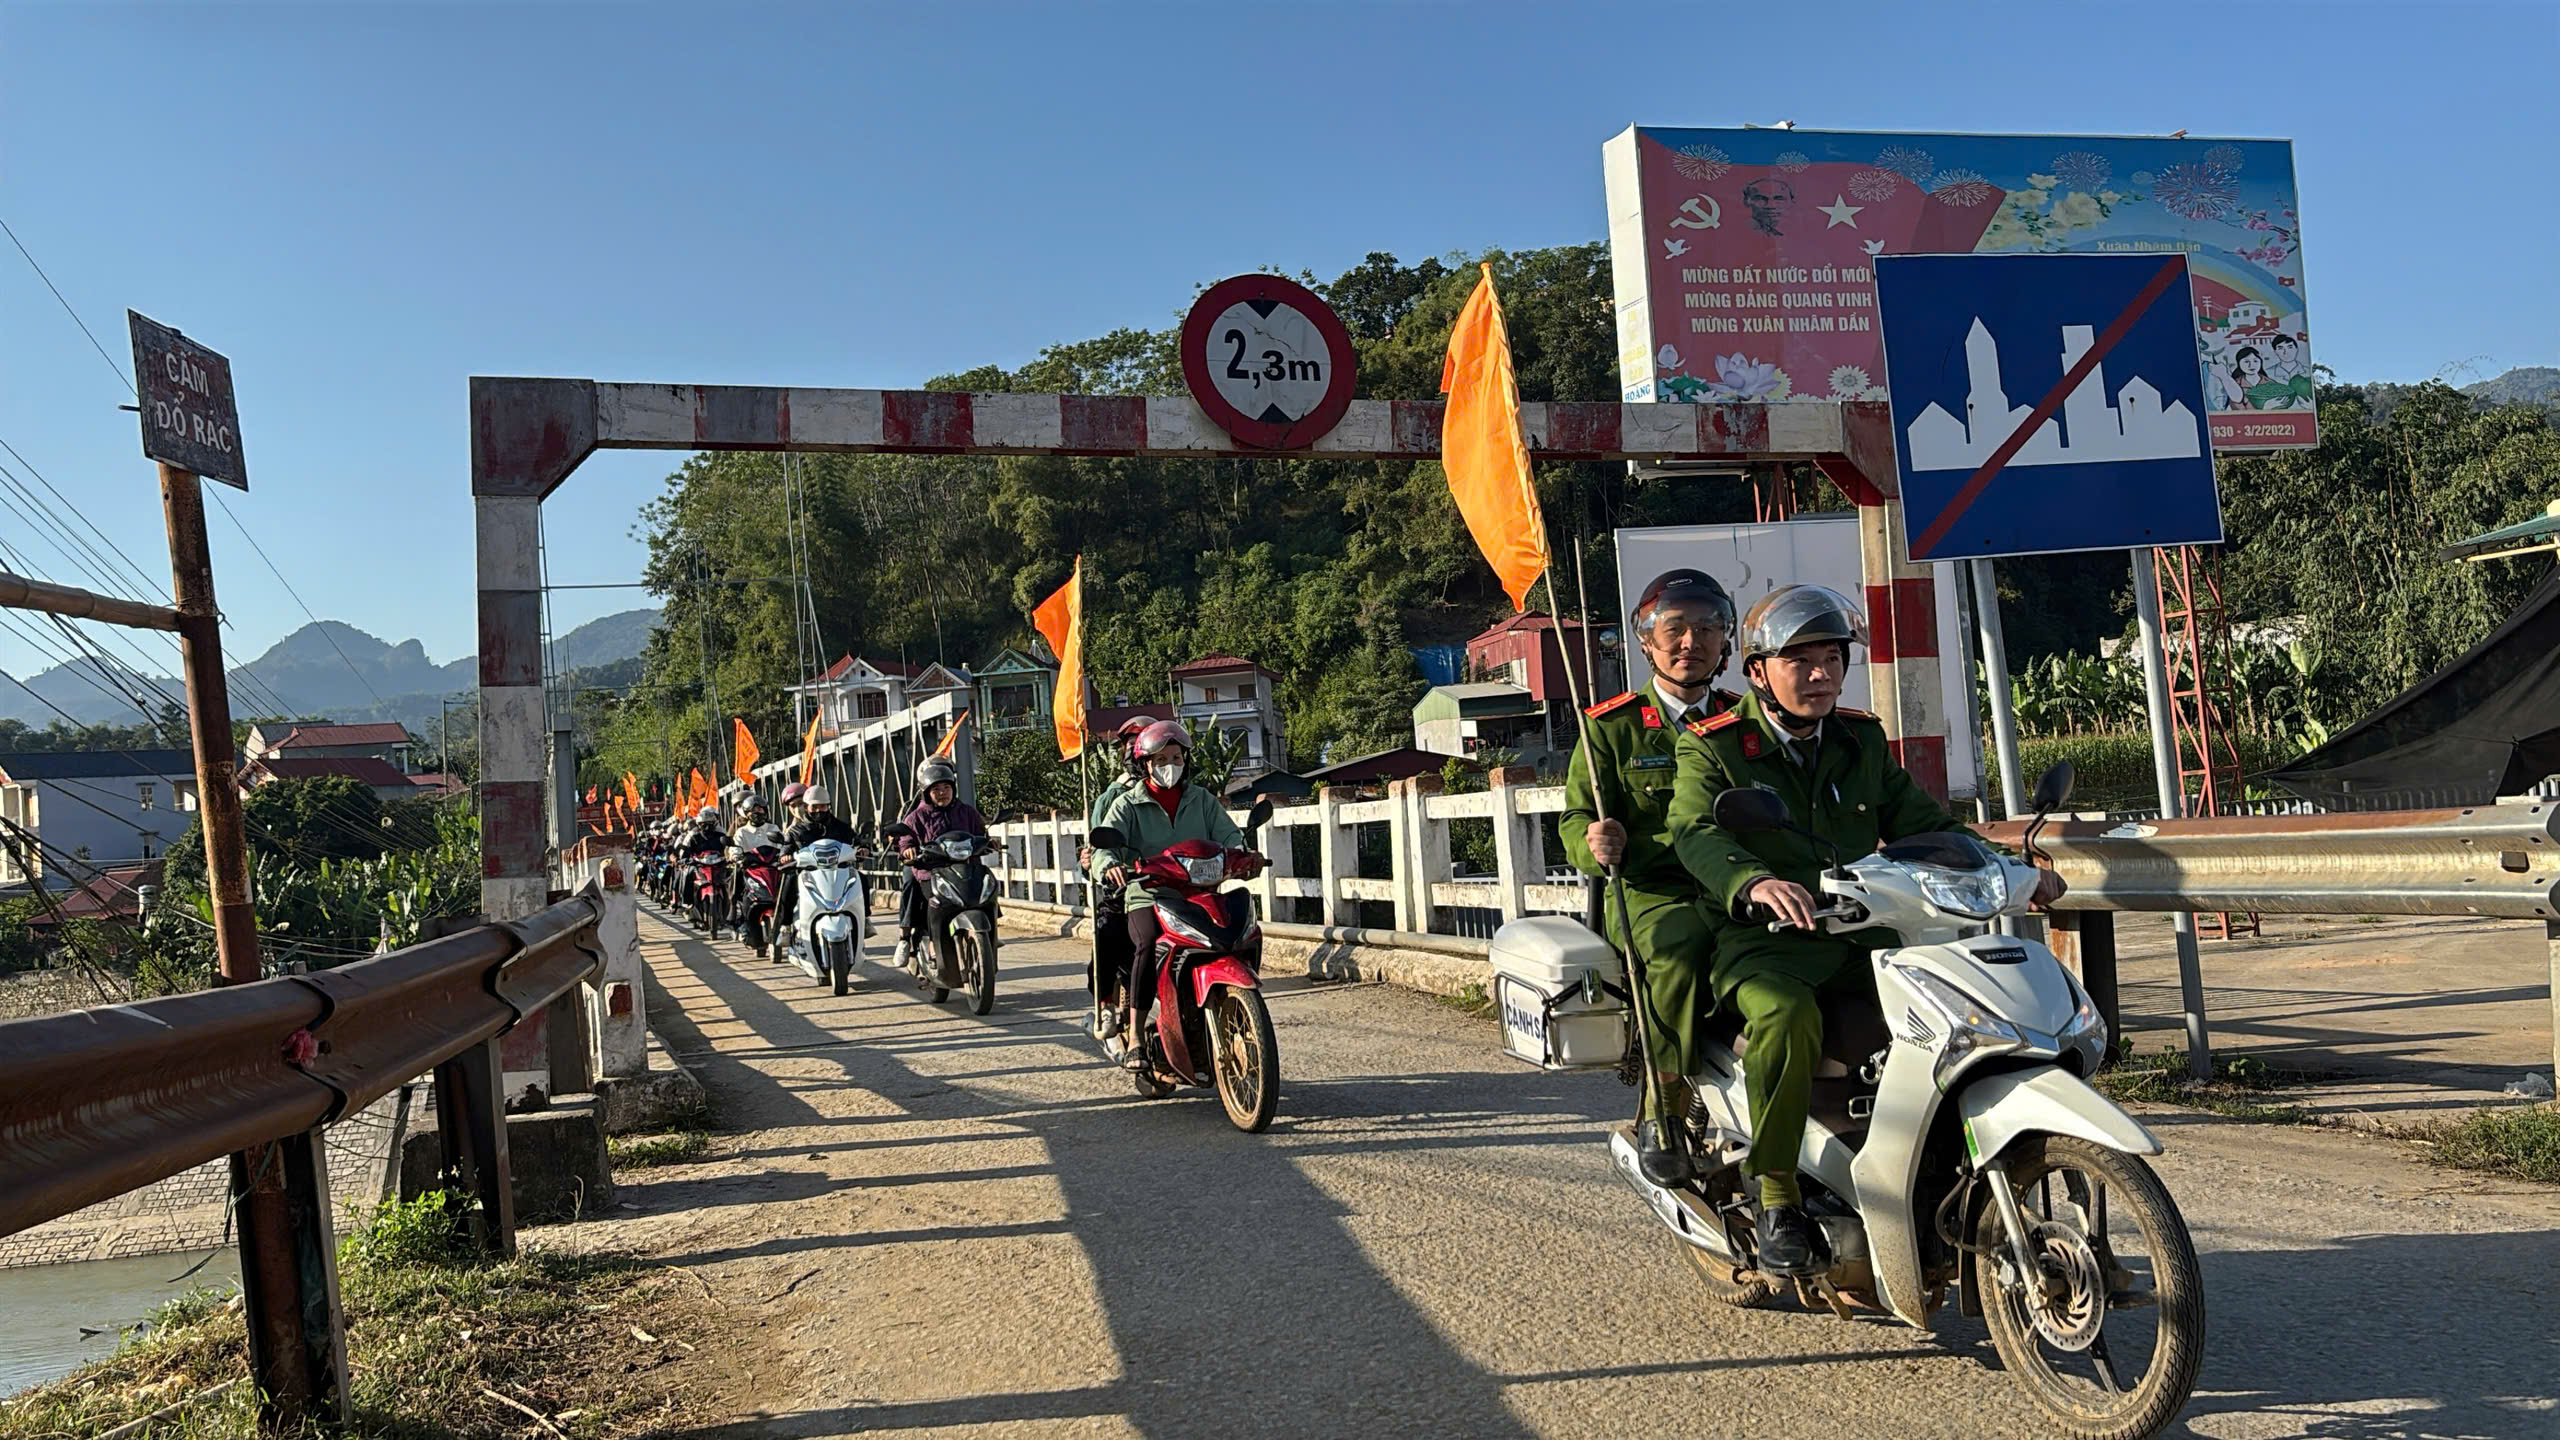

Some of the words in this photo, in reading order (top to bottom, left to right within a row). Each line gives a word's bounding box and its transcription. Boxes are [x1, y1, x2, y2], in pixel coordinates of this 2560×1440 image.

[1682, 265, 1729, 283] MỪNG
[1733, 264, 1762, 283] ĐẤT
[1766, 266, 1808, 283] NƯỚC
[1812, 262, 1838, 283] ĐỔI
[1842, 266, 1871, 283] MỚI
[1684, 290, 1731, 308] MỪNG
[1735, 289, 1778, 308] ĐẢNG
[1782, 293, 1833, 309] QUANG
[1836, 293, 1872, 307] VINH
[1691, 315, 1738, 333] MỪNG
[1742, 315, 1785, 333] XUÂN
[1788, 314, 1834, 332] NHÂM
[1838, 312, 1870, 331] DẦN
[1224, 329, 1321, 389] 2,3m
[166, 350, 210, 397] CẤM
[156, 391, 187, 437] ĐỔ
[192, 410, 232, 453] RÁC
[2244, 424, 2296, 437] 3/2/2022)
[1896, 1032, 1934, 1054] HONDA
